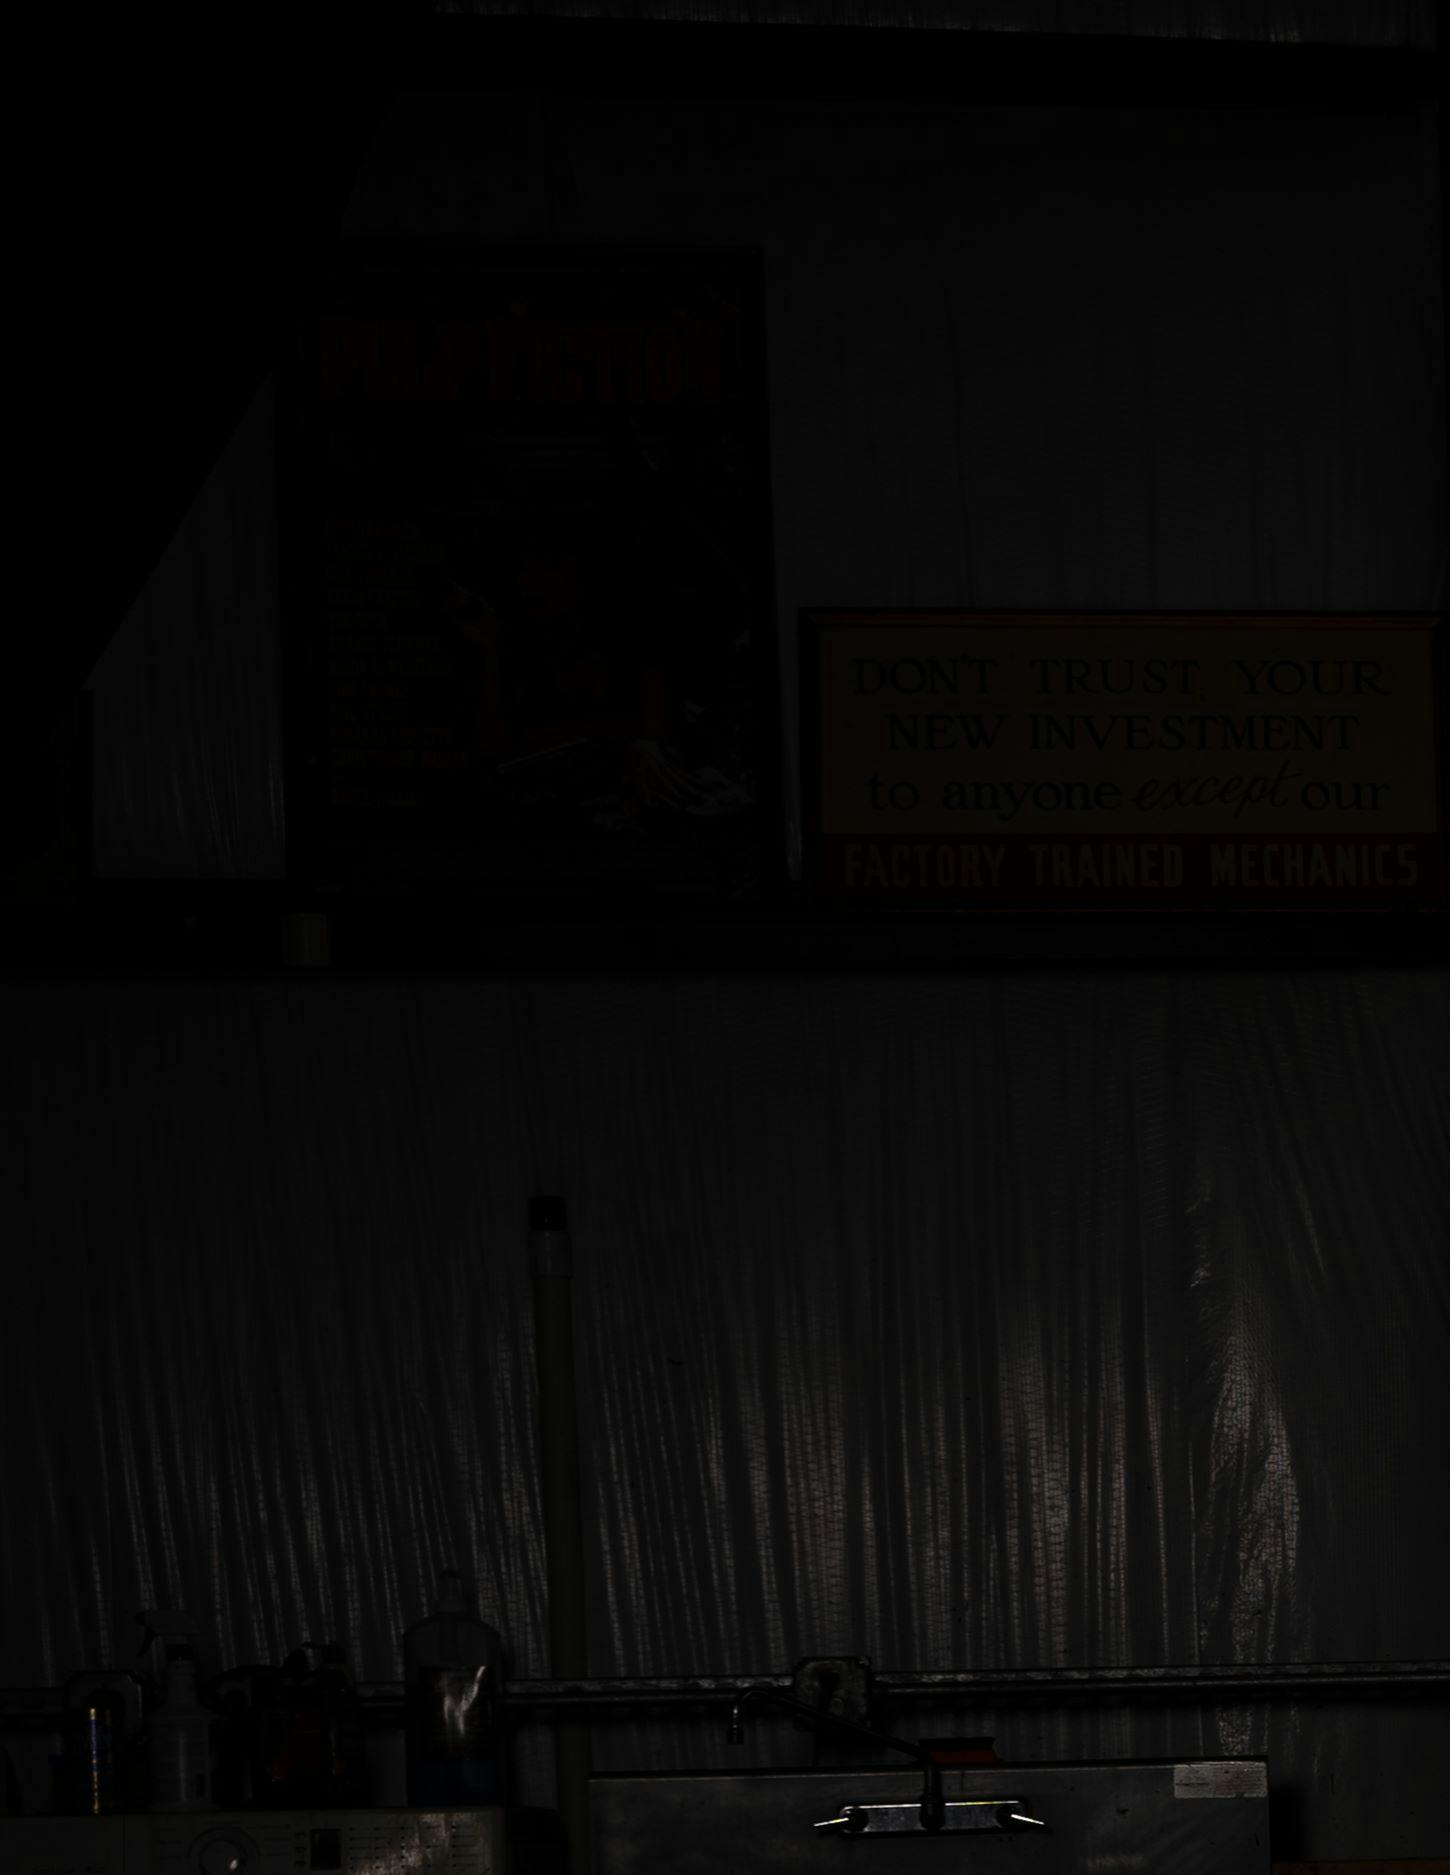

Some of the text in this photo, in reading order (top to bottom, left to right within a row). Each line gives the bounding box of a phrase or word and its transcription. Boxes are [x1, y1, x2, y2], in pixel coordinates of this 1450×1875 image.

[852, 650, 1393, 698] DON'T TRUST YOUR
[883, 711, 1361, 752] NEW INVESTMENT
[866, 760, 1393, 822] to anyone except our
[842, 842, 1419, 889] FACTORY TRAINED MECHANICS
